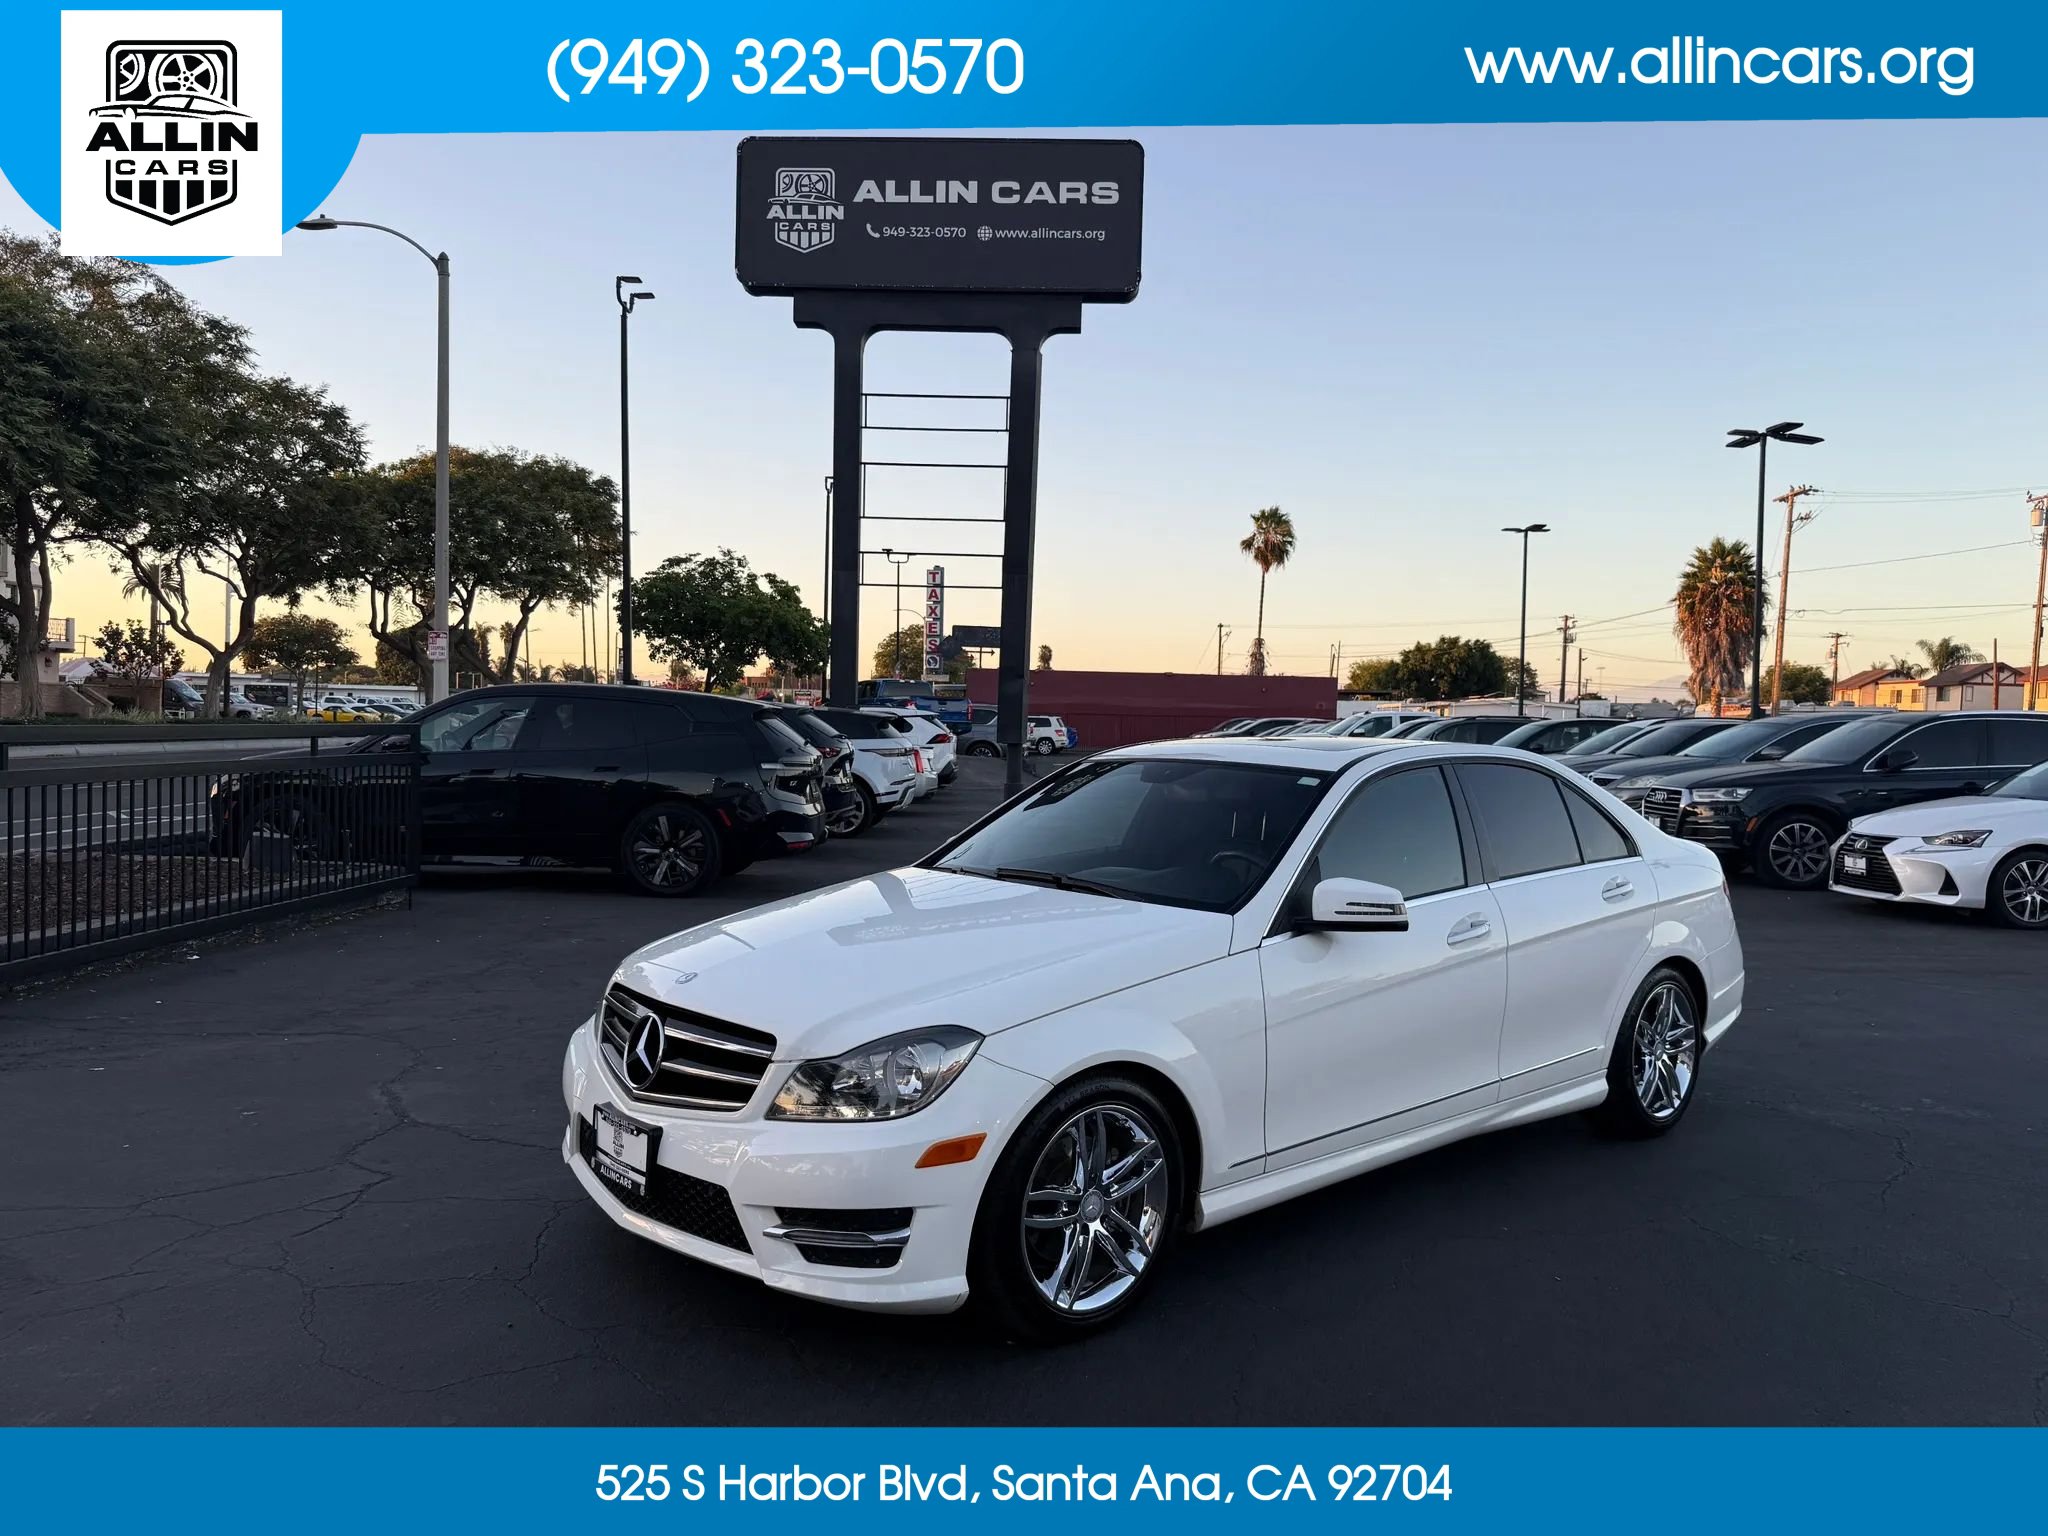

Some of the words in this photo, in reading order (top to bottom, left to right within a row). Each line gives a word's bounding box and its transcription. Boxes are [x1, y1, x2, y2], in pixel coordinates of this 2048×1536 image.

[853, 179, 978, 204] ALLIN
[991, 181, 1120, 205] CARS
[766, 204, 845, 220] ALLIN
[779, 222, 831, 231] CARS
[882, 226, 967, 238] 949-323-0570
[994, 227, 1106, 242] www.allincars.org
[928, 571, 940, 654] TAXES
